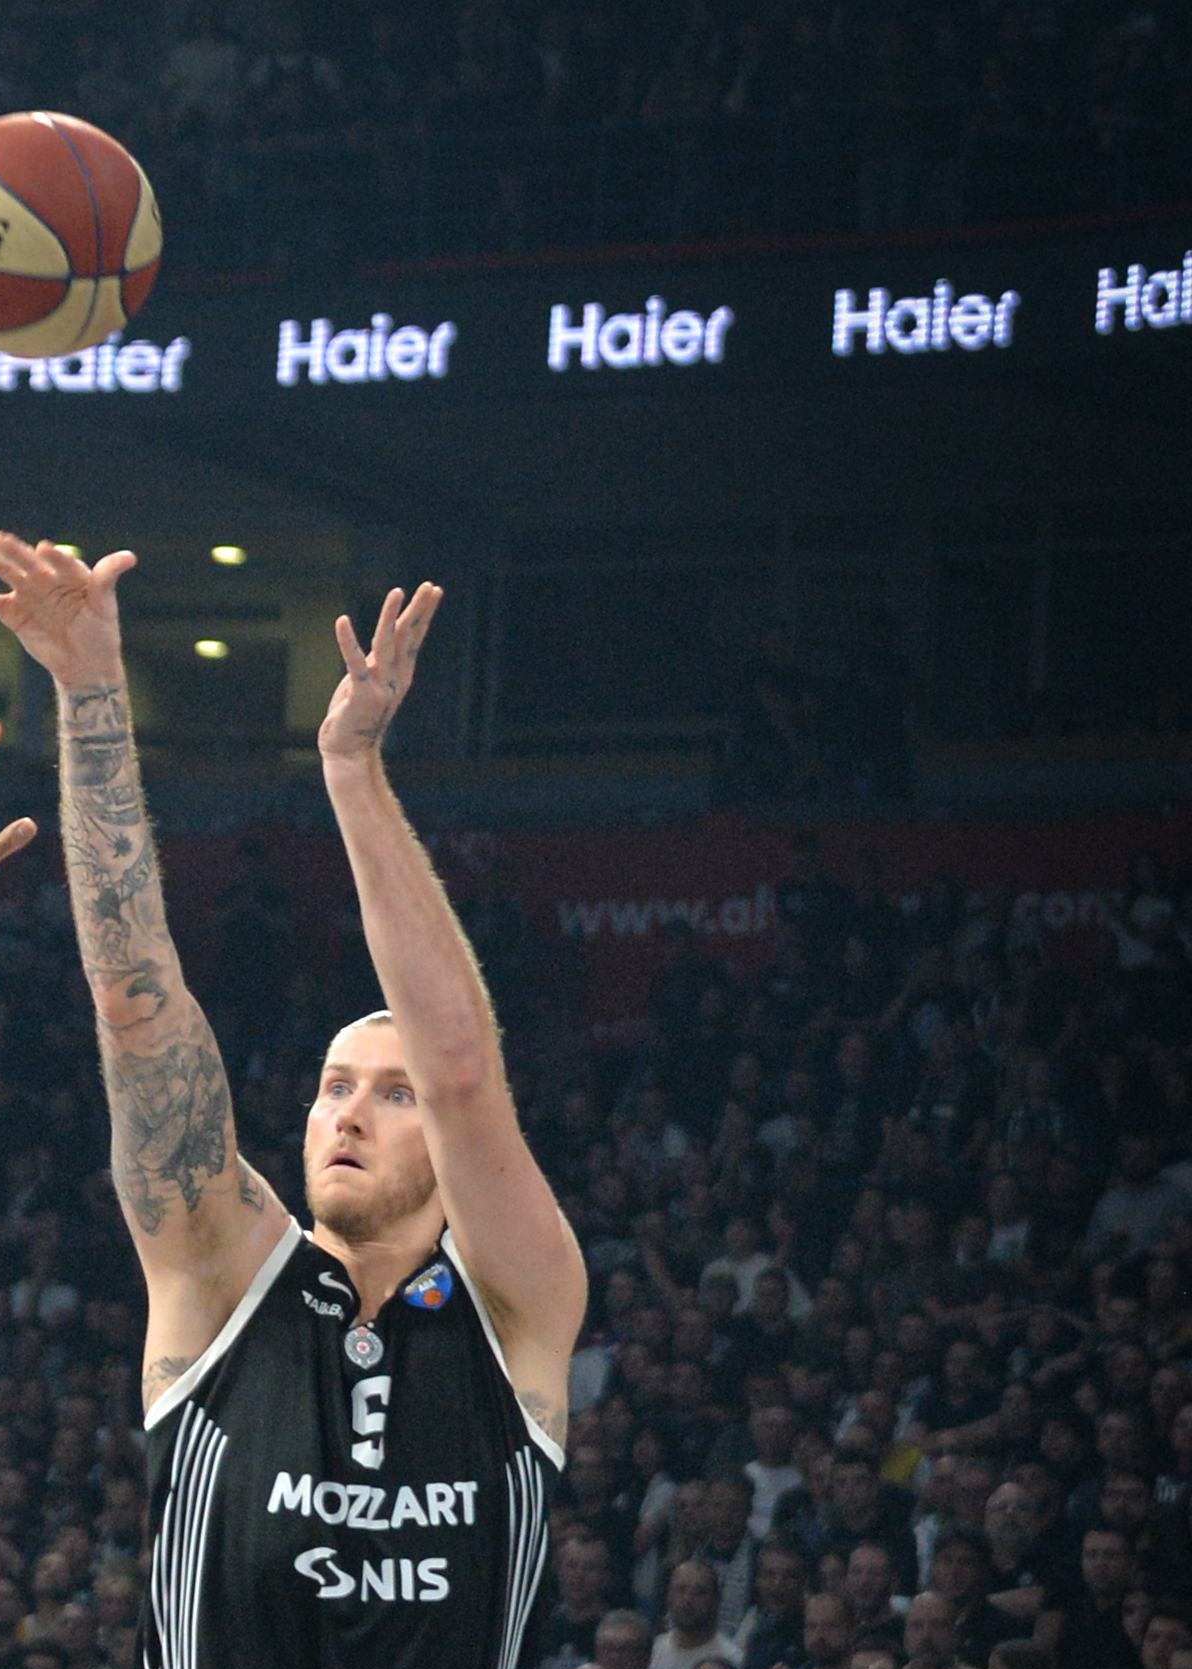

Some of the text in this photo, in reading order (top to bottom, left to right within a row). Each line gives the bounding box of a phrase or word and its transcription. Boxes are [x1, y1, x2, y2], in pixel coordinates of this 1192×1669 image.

[277, 312, 458, 388] Haier
[548, 295, 736, 373] Haier
[832, 279, 1021, 357] Haier
[267, 1471, 478, 1530] MOZZART
[360, 1558, 451, 1603] NIS
